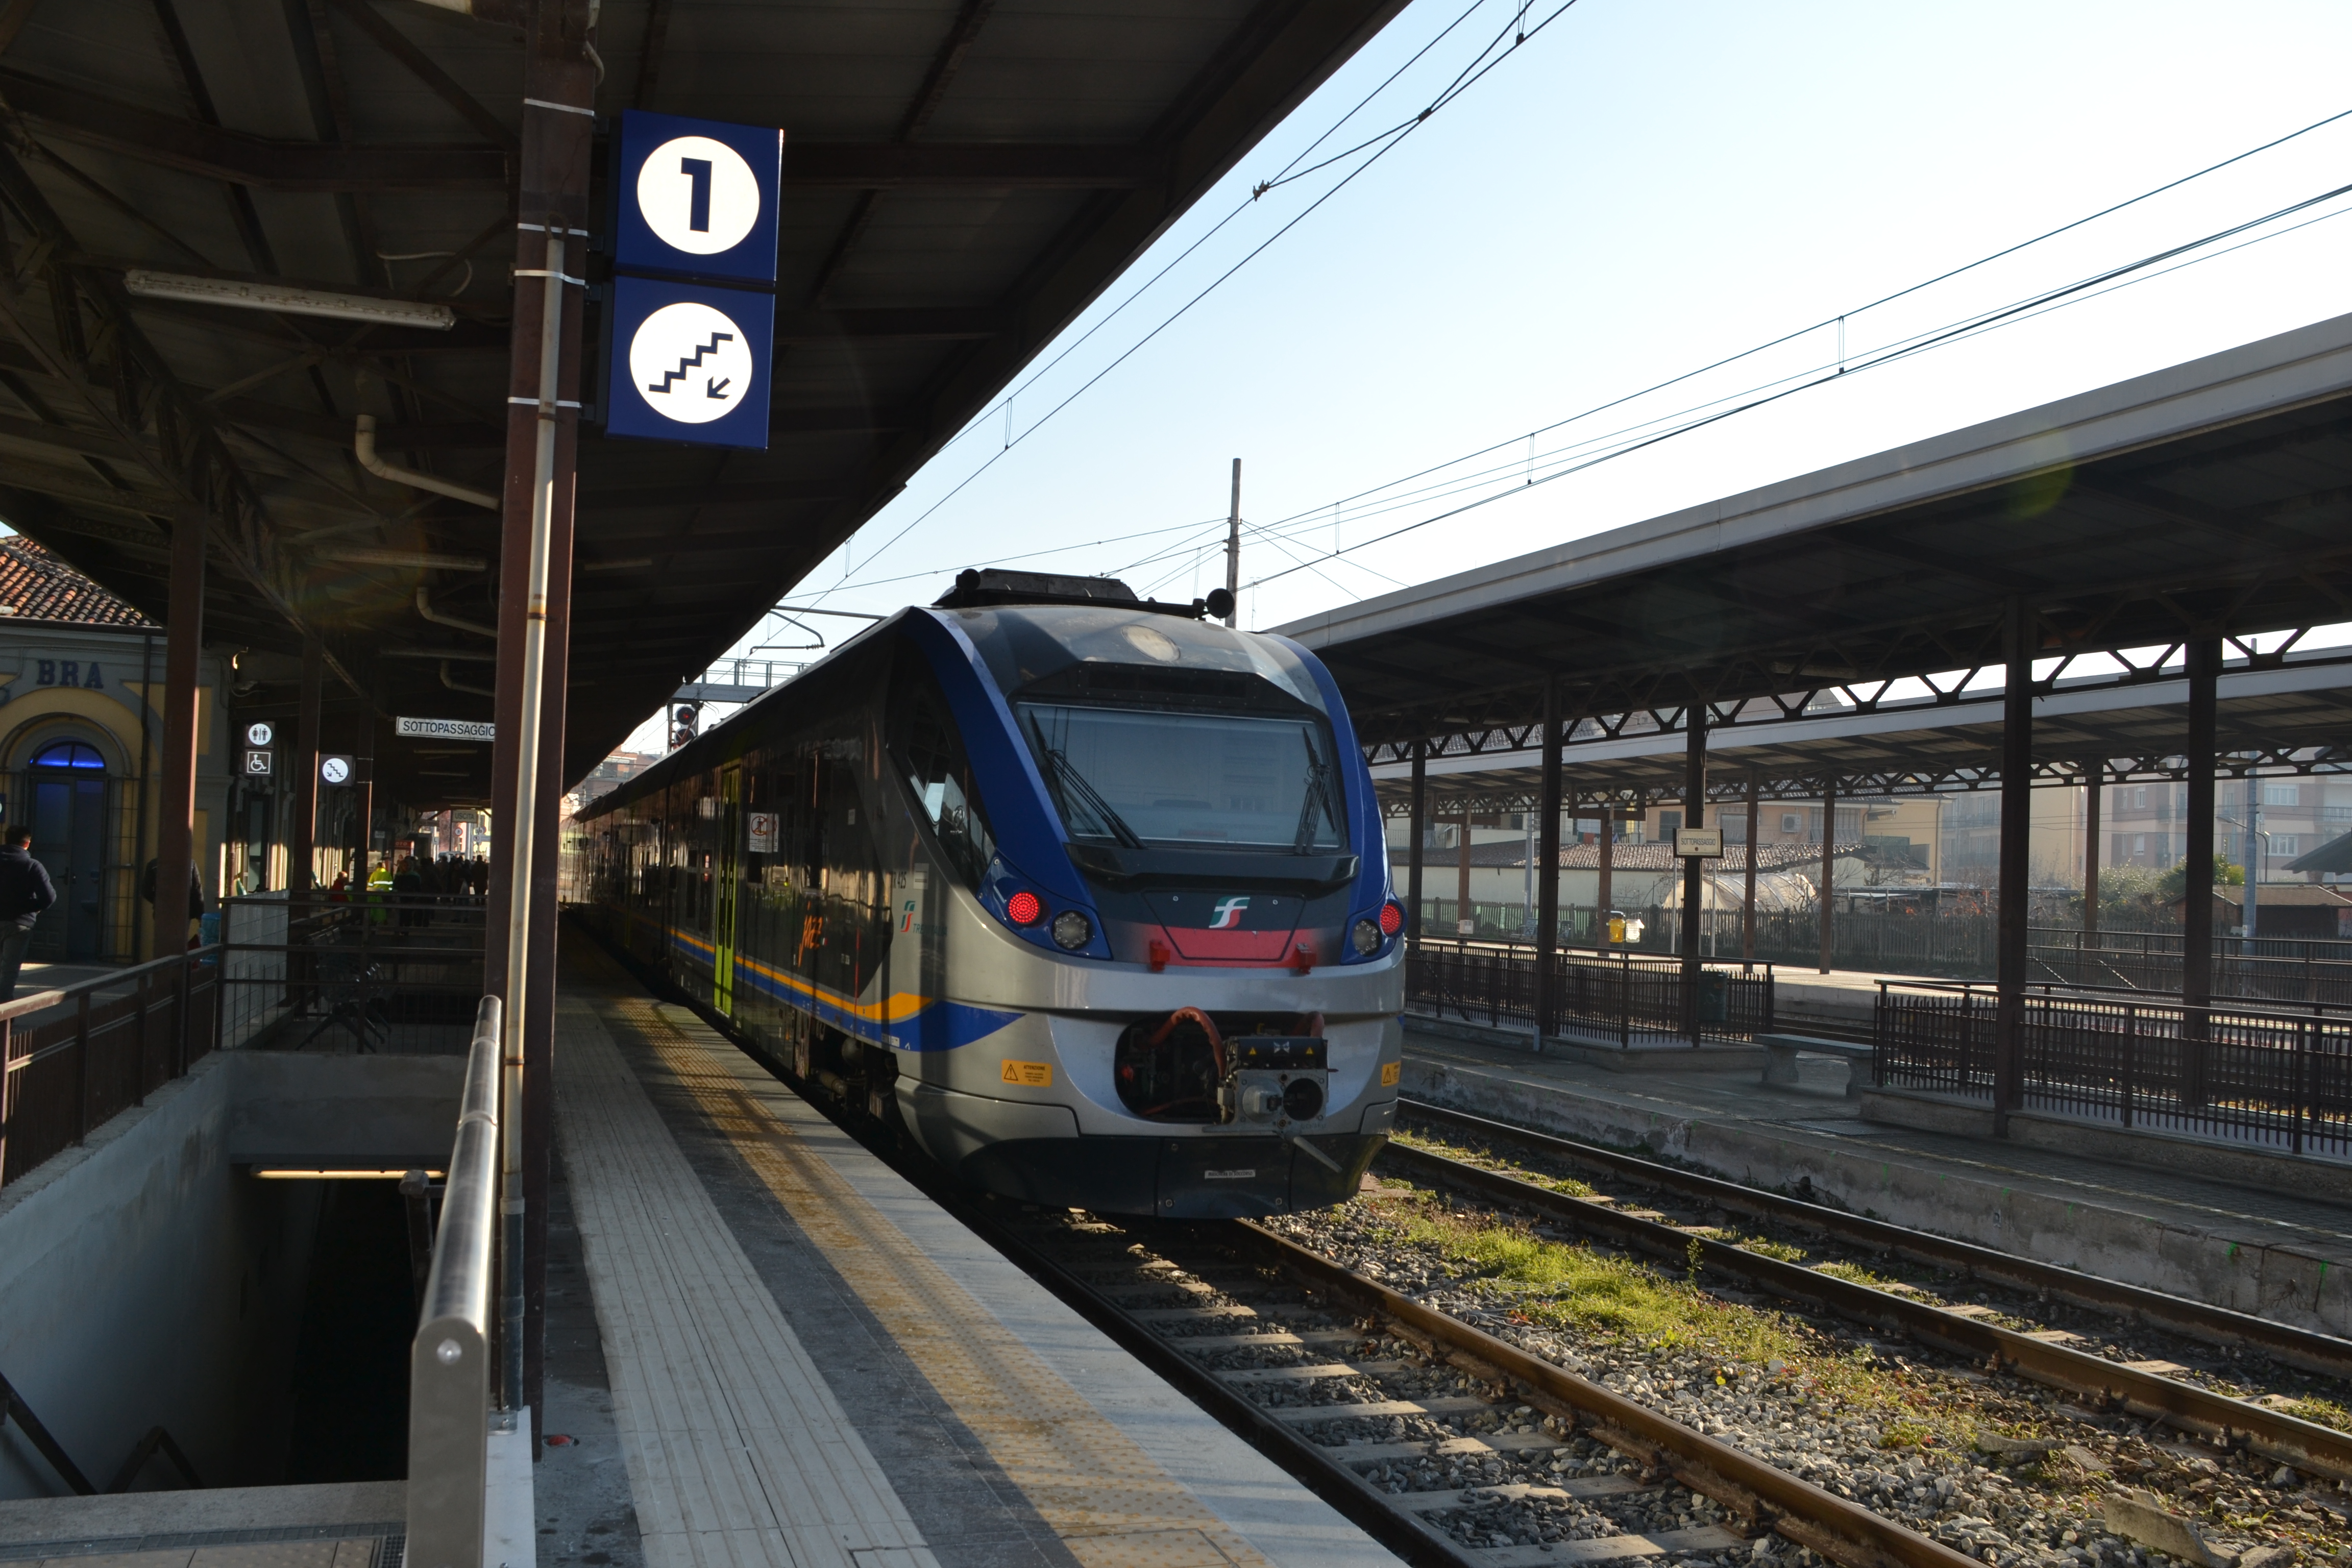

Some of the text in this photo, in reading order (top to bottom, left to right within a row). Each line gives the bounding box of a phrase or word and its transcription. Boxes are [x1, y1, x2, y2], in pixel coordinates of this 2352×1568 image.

[680, 156, 713, 233] 1
[36, 659, 104, 689] BRA
[403, 720, 495, 737] SOTTOPASSAGGIO
[1680, 838, 1716, 846] SOTTOPASSAGGIO
[897, 871, 906, 889] 425
[913, 923, 947, 937] TRETALIA
